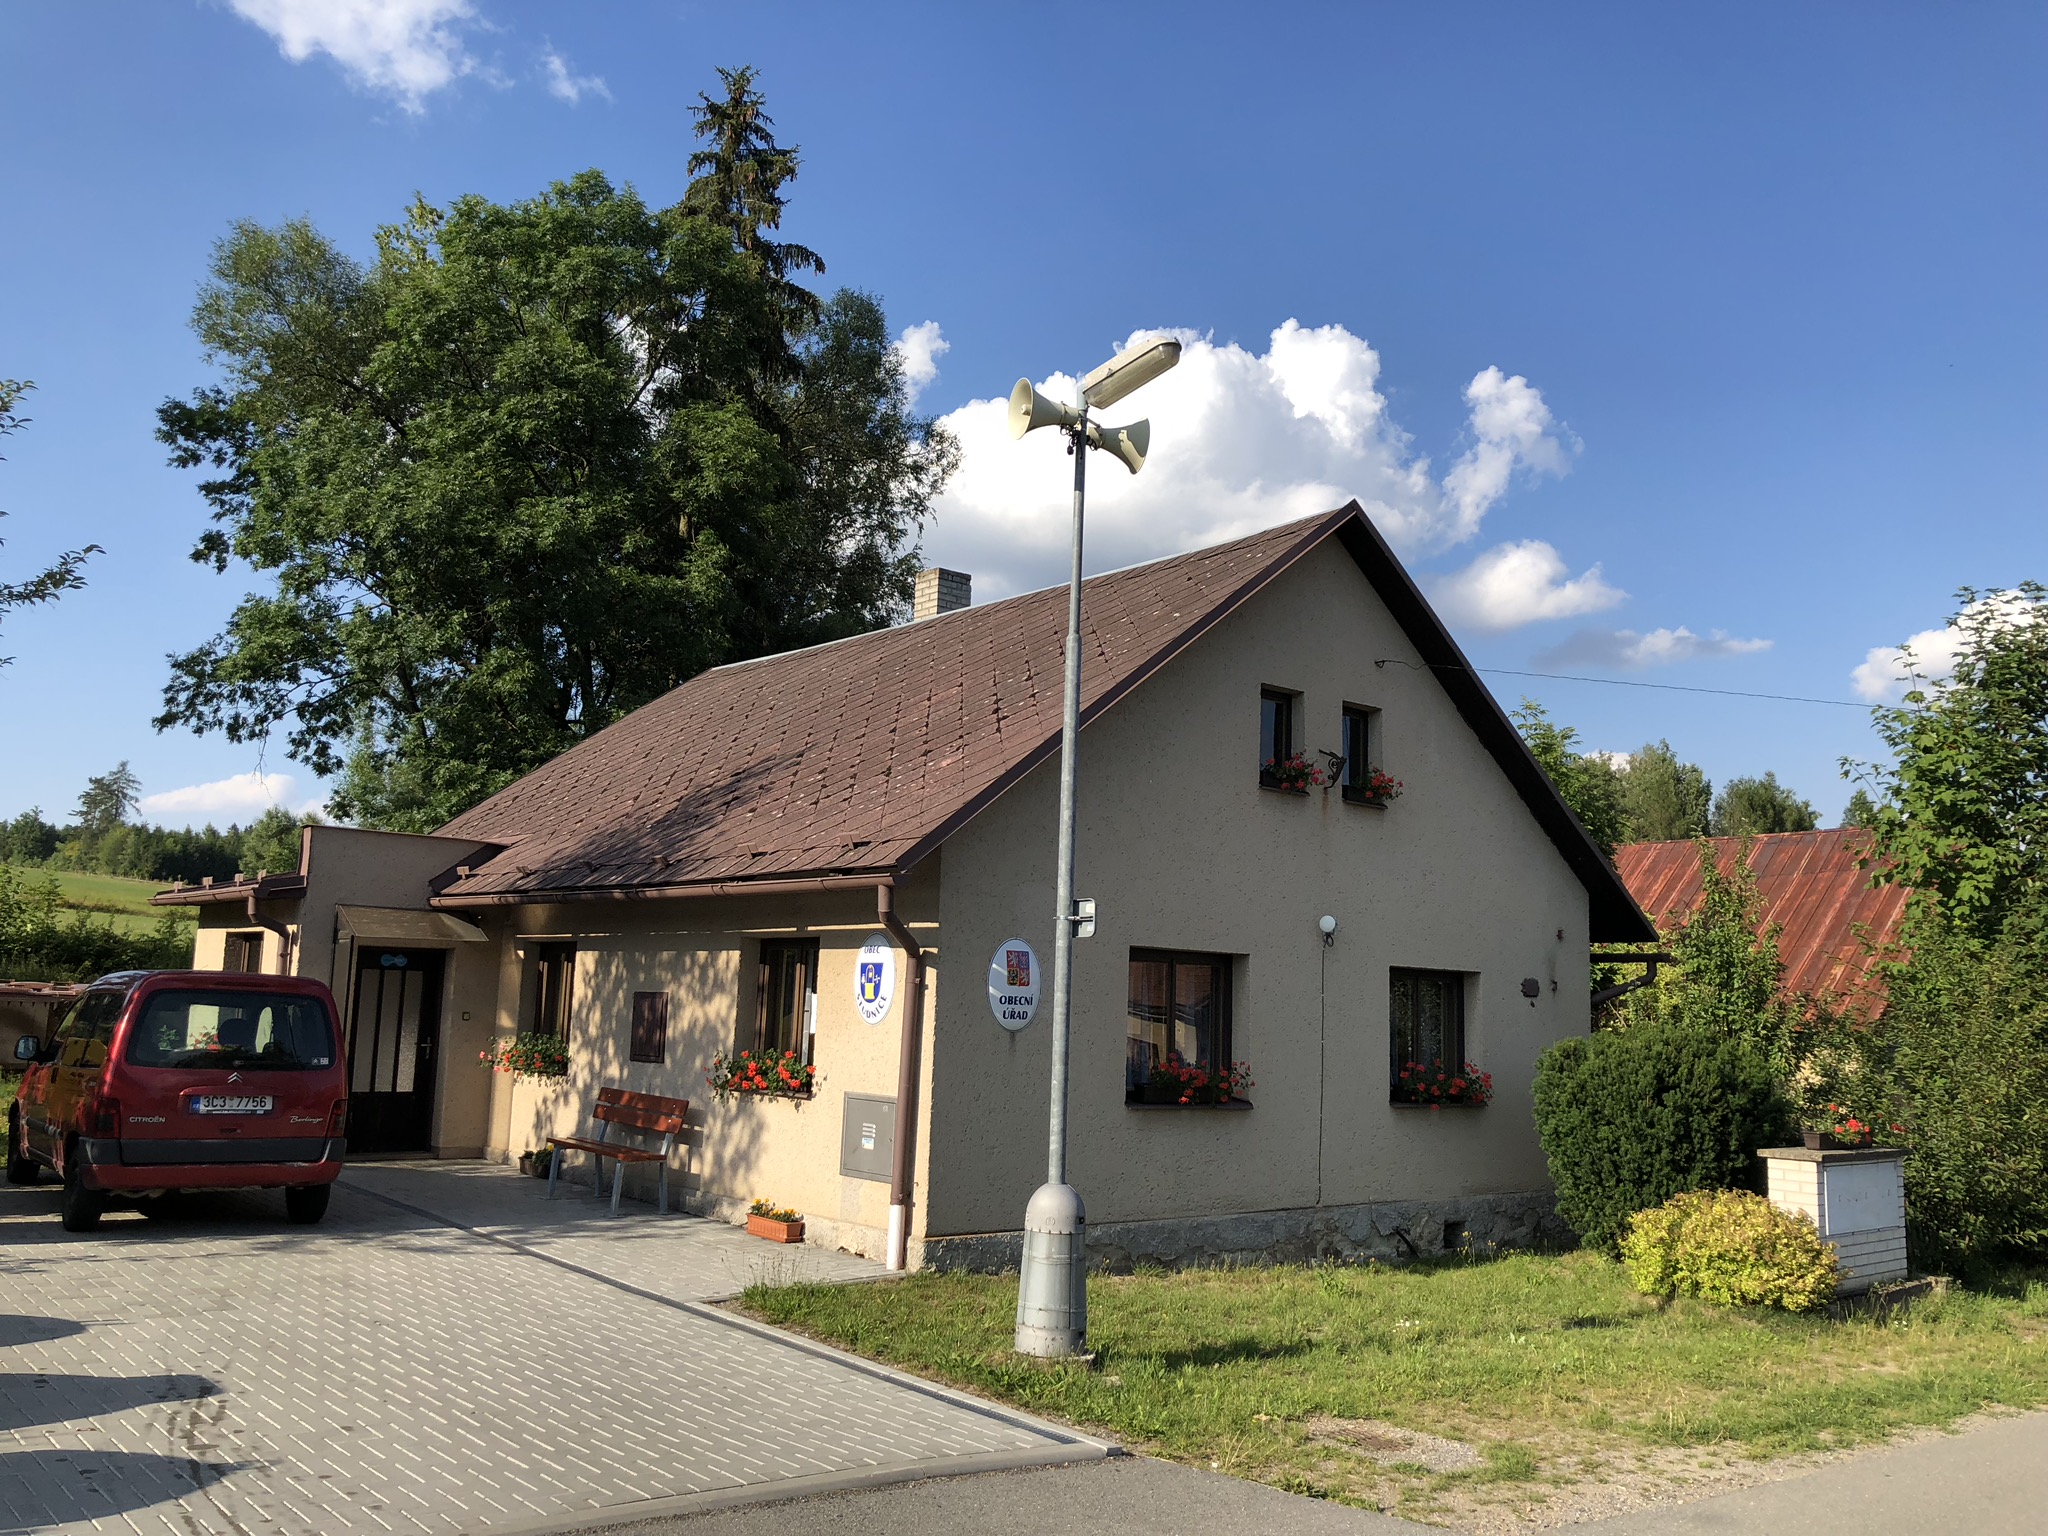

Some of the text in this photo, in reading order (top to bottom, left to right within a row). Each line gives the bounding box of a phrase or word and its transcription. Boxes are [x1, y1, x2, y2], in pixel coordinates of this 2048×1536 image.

[999, 994, 1034, 1006] OBECNÍ
[1003, 1007, 1028, 1020] ÚŘAD
[203, 1096, 267, 1108] 3C3 7756
[129, 1115, 166, 1123] CITROËN
[290, 1115, 324, 1124] Berlingo
